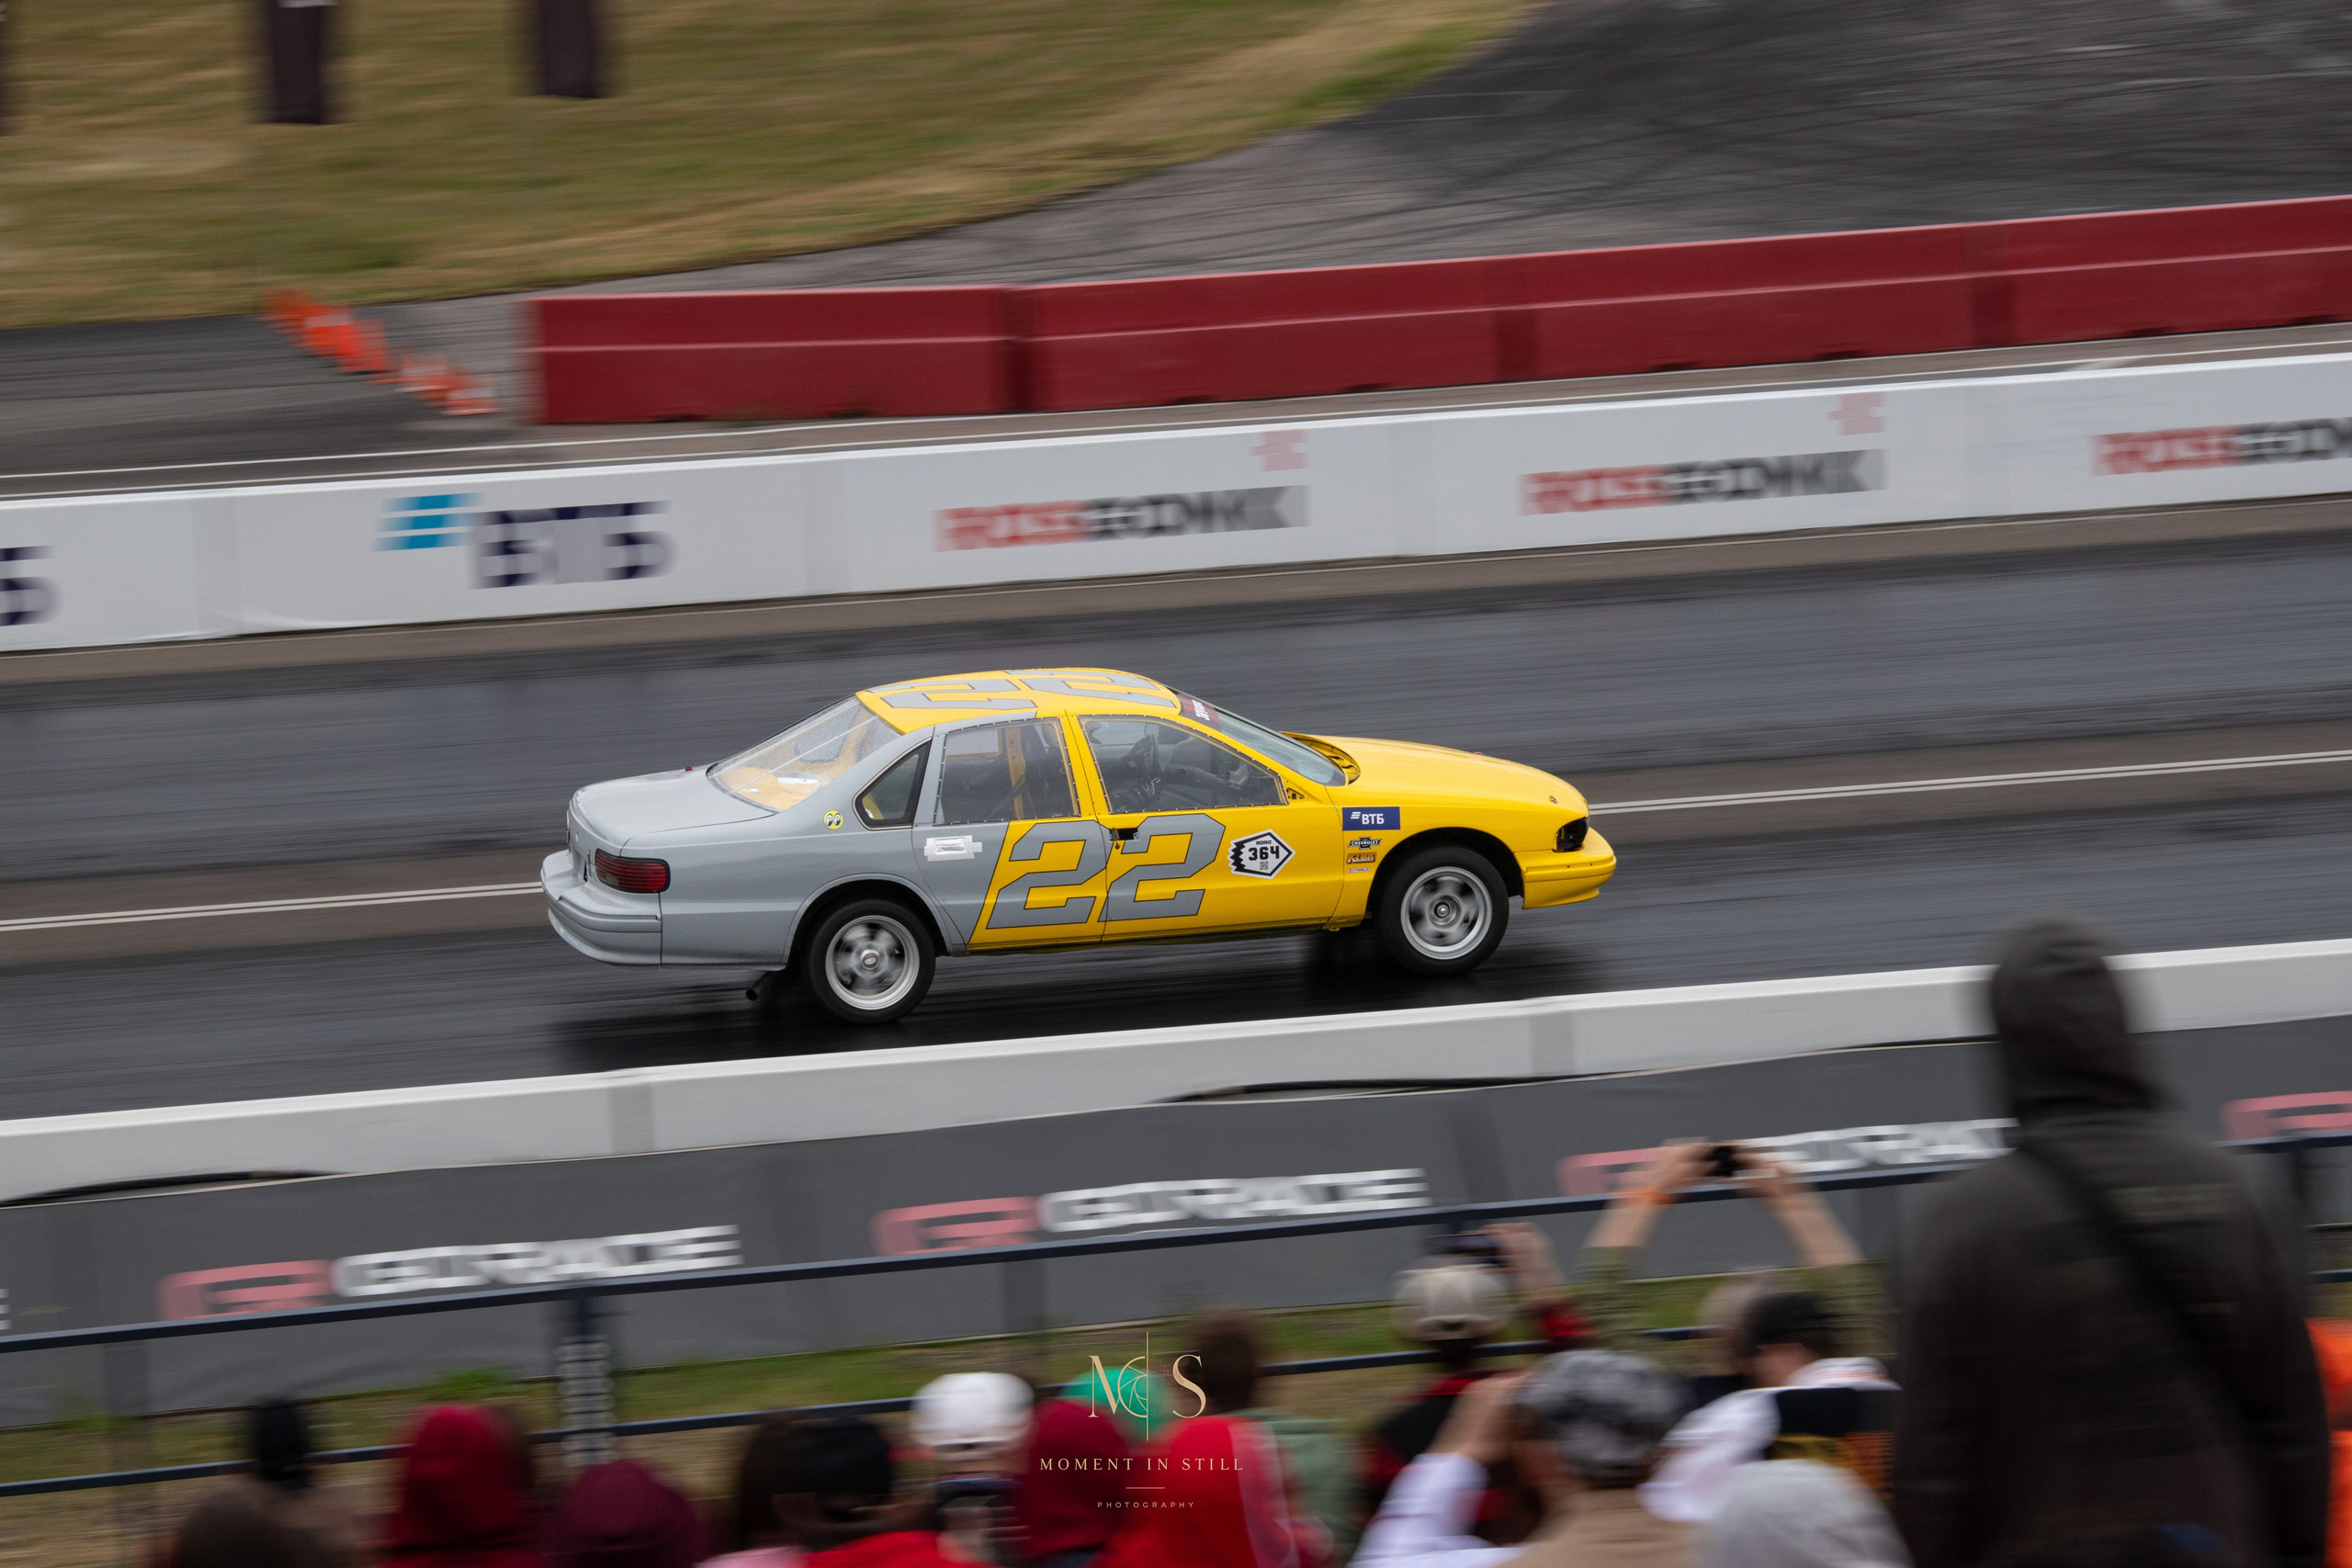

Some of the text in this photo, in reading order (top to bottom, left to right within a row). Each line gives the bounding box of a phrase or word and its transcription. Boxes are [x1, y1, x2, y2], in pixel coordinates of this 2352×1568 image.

[1362, 813, 1385, 825] ВТБ
[1248, 845, 1280, 862] 364
[986, 813, 1227, 930] 22
